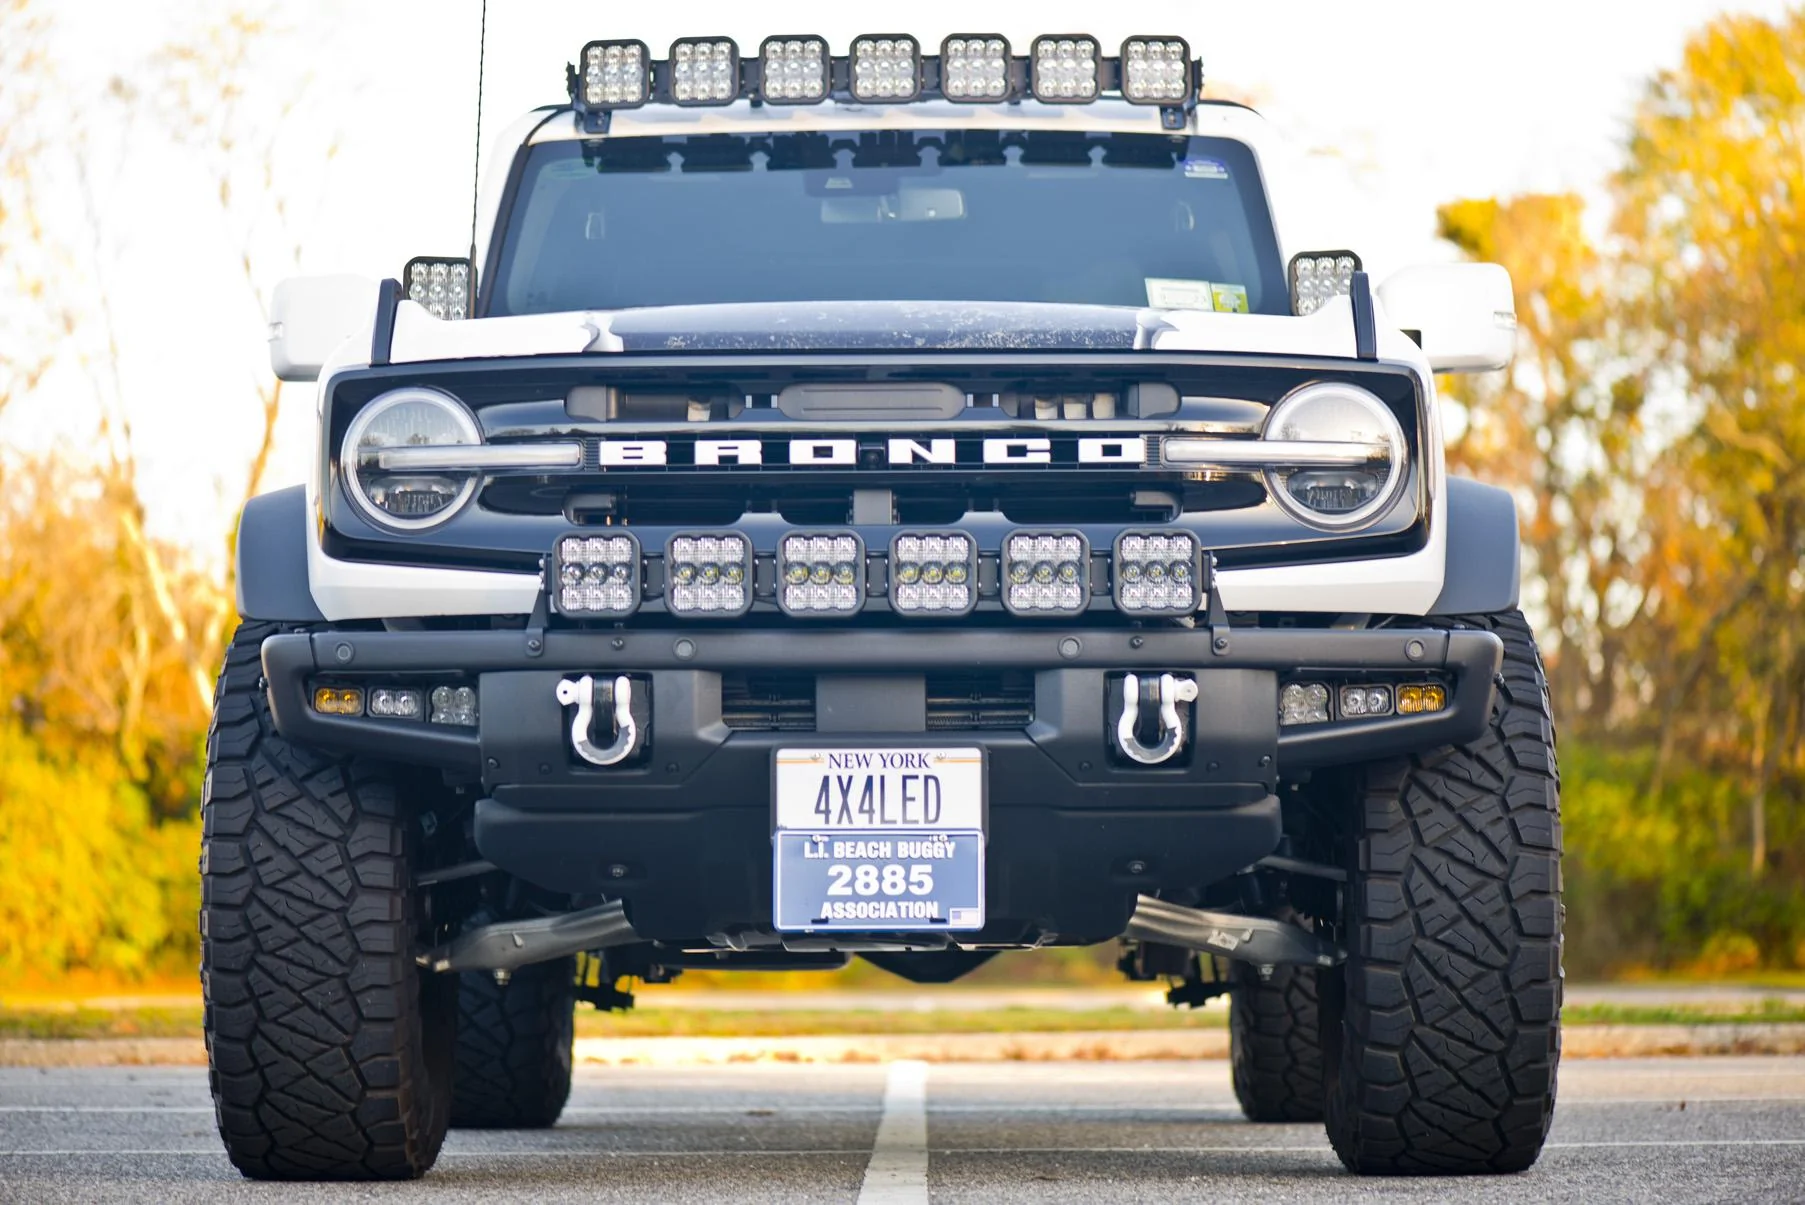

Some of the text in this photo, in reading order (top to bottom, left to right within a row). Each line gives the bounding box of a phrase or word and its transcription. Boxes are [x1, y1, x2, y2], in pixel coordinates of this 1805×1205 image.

[600, 438, 1145, 465] BRONCO
[829, 753, 930, 768] NEW YORK
[814, 775, 941, 825] 4X4LED
[834, 842, 892, 858] BEACH
[898, 842, 955, 858] BUGGY
[827, 864, 934, 896] 2885
[820, 902, 939, 919] ASSOCIATION
